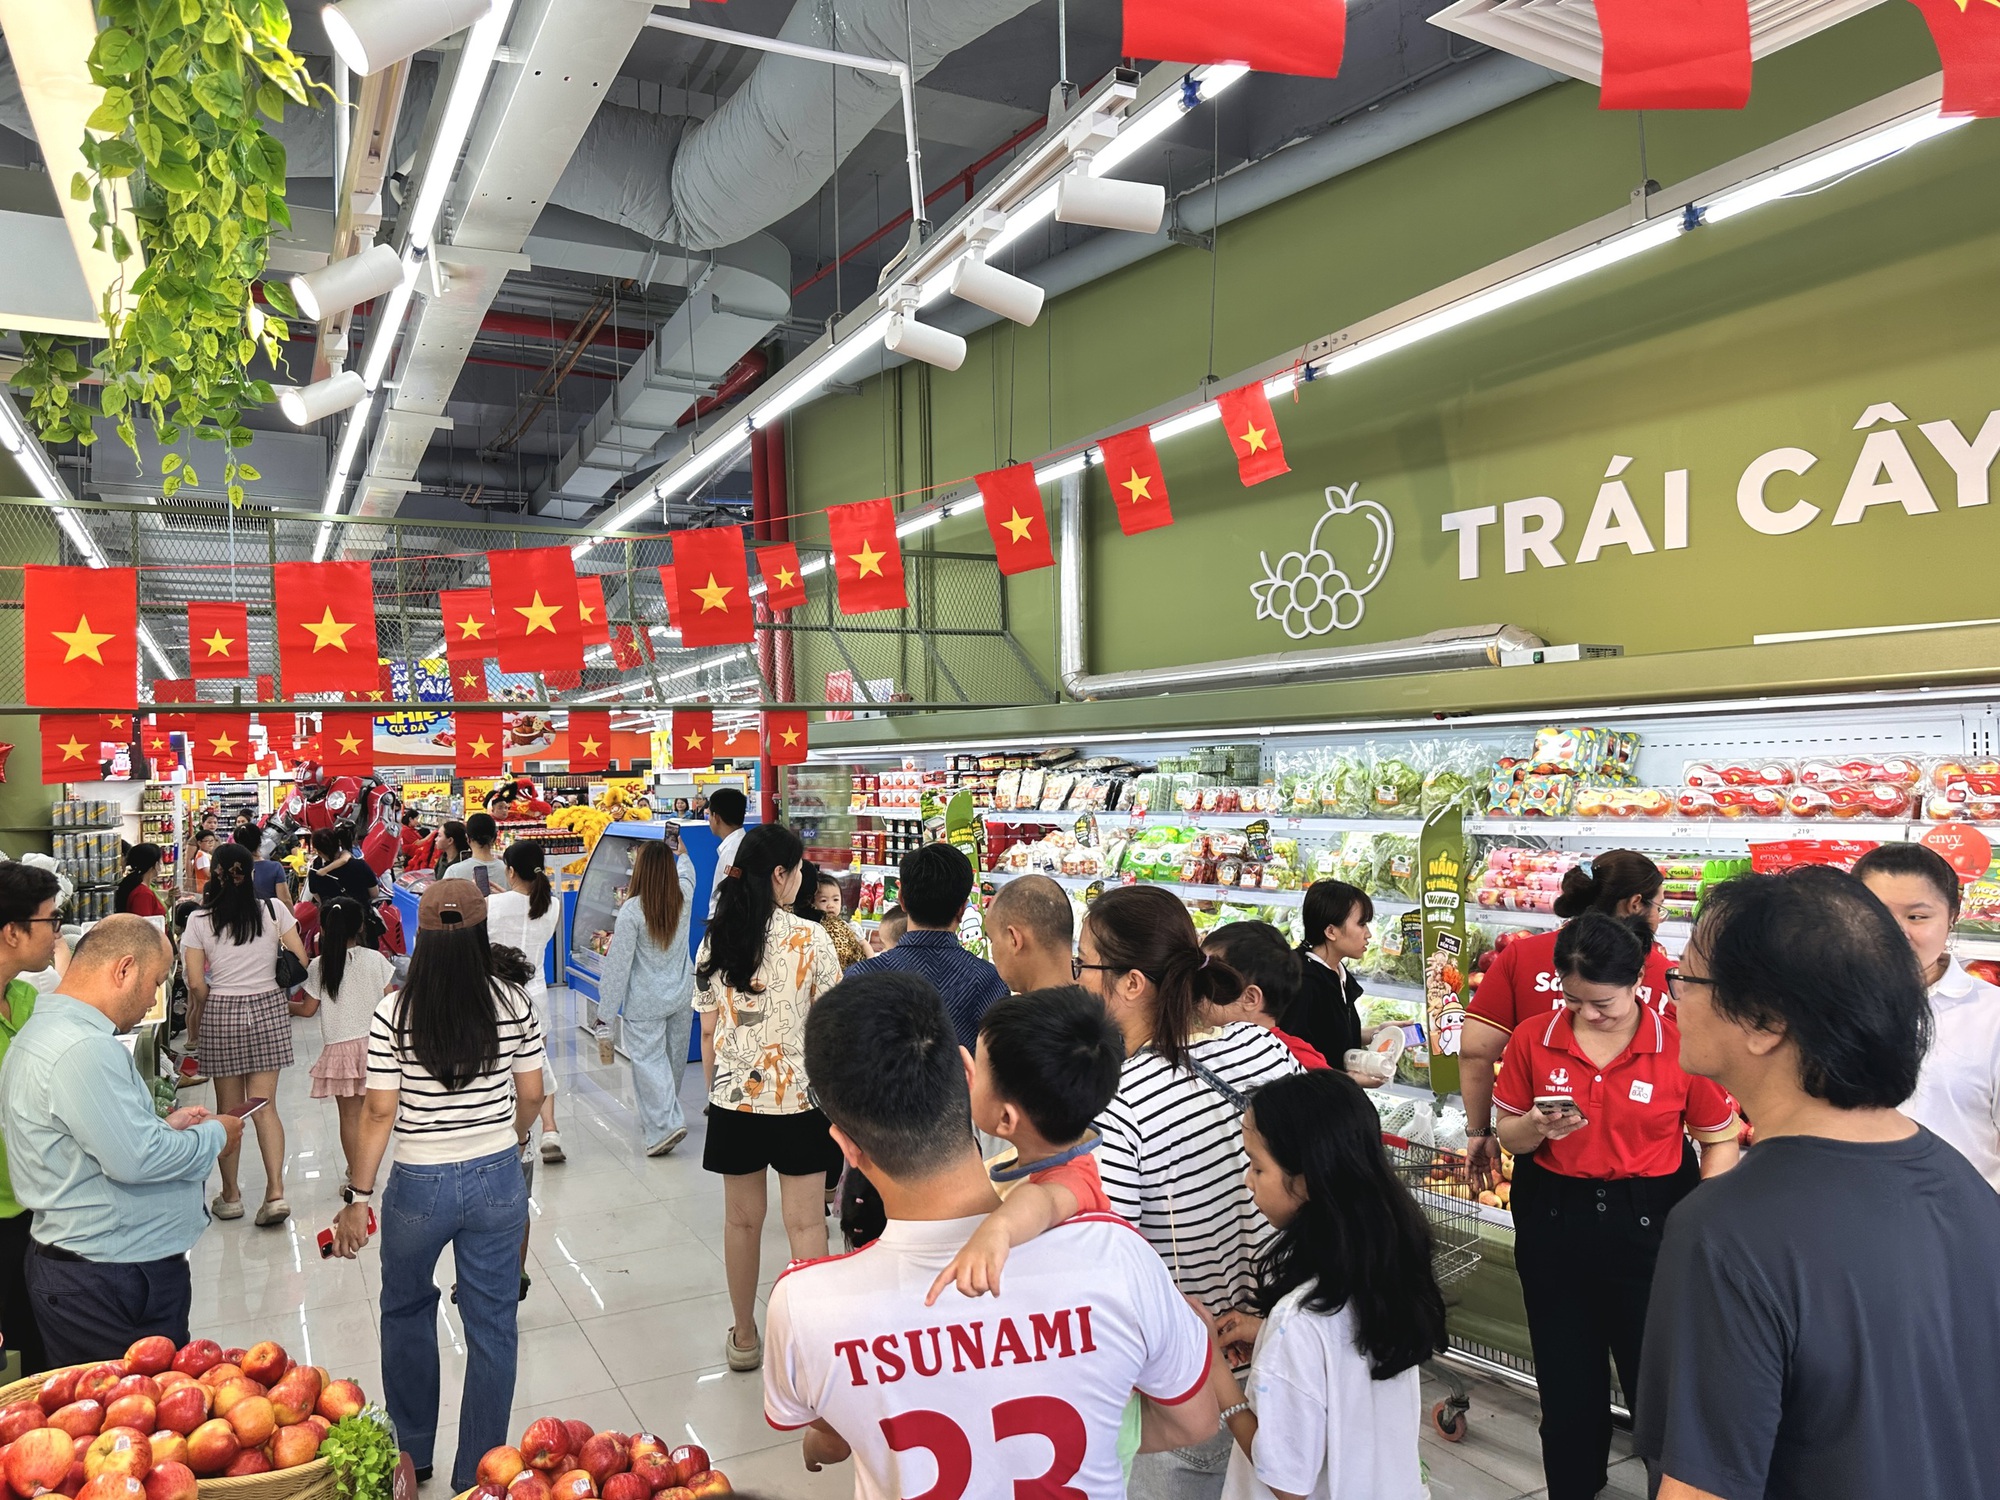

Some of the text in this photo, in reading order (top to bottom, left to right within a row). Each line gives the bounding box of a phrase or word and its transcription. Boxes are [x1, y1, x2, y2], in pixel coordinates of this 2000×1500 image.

[1442, 401, 2000, 581] TRÁI CÂY
[1927, 833, 1965, 850] envy
[1436, 878, 1458, 891] nhiên
[1556, 1085, 1573, 1093] PHÁT
[834, 1305, 1097, 1386] TSUNAMI
